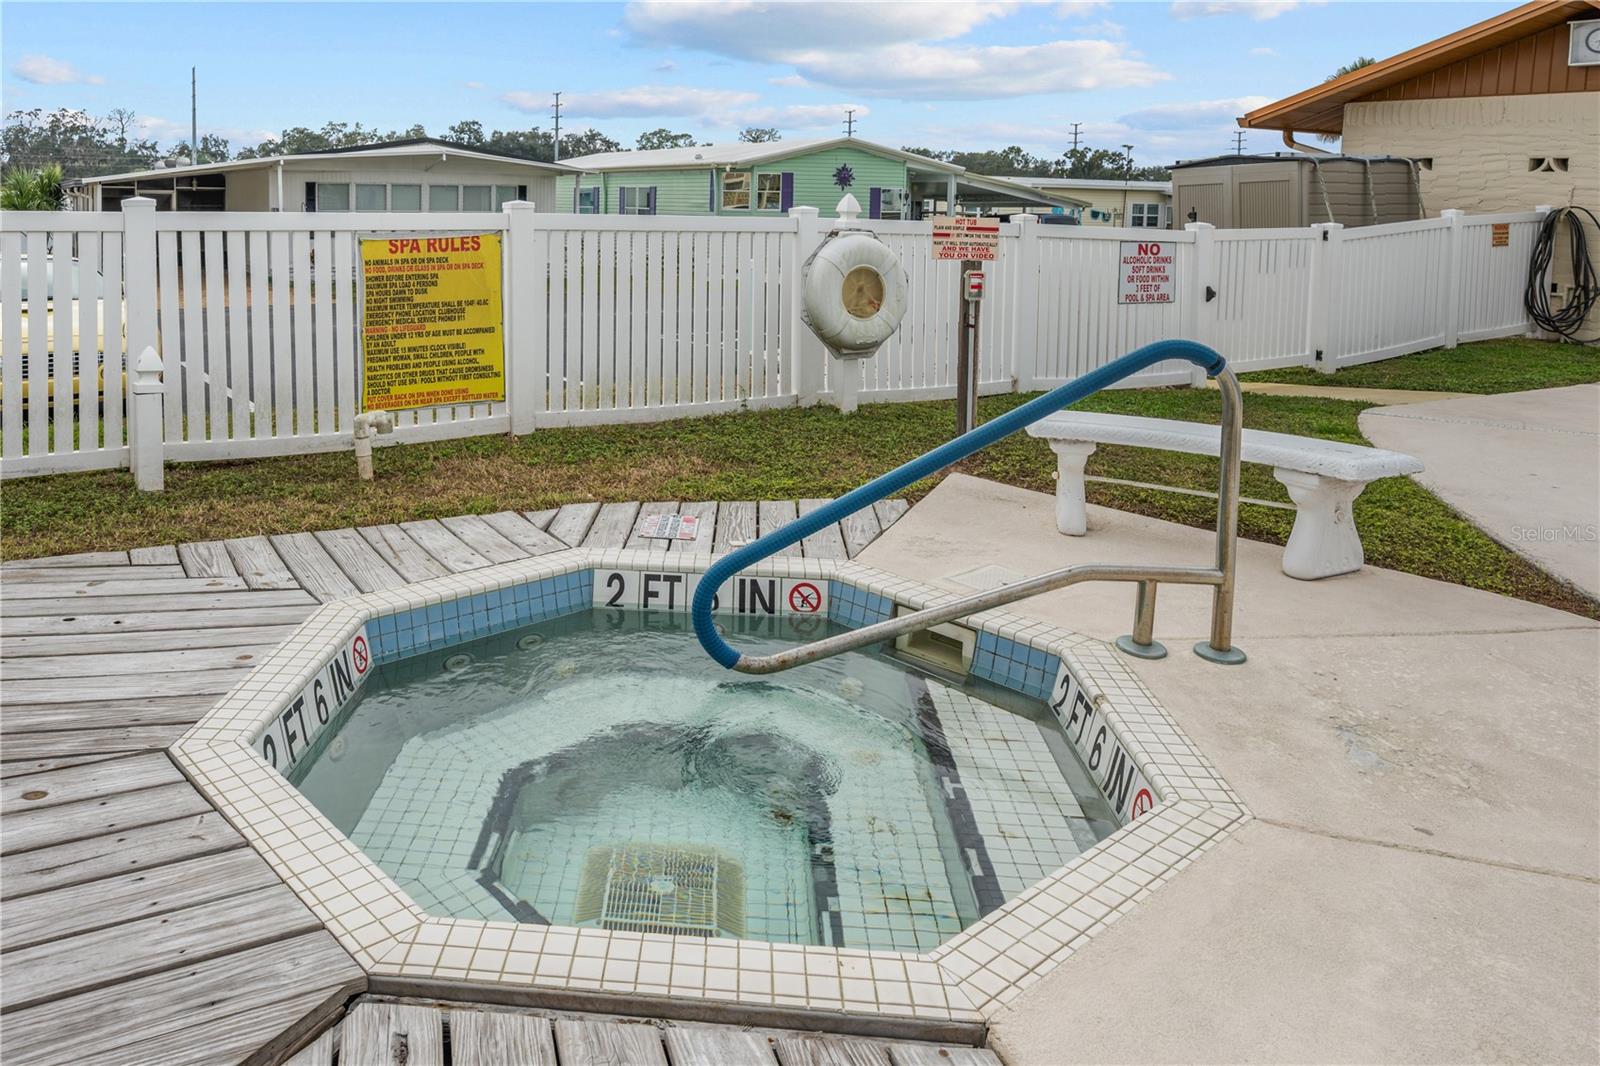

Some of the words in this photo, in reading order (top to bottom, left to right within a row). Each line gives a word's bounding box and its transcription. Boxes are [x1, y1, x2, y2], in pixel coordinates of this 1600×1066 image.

[389, 239, 420, 254] SPA
[427, 236, 481, 253] RULES
[1138, 243, 1160, 256] NO
[1123, 256, 1152, 264] ALCOHOLIC
[1152, 256, 1172, 264] DRINKS
[1132, 265, 1145, 273] SOFT
[1146, 265, 1166, 273] DRINKS
[1127, 275, 1135, 283] OR
[1136, 275, 1150, 283] FOOD
[1136, 284, 1139, 292] 3
[1140, 284, 1152, 292] FEET
[1154, 284, 1160, 292] OF
[1125, 294, 1139, 302] POOL
[1146, 294, 1155, 302] SPA
[407, 302, 440, 310] TEMPERATURE
[464, 327, 495, 335] ACCOMPANIED
[473, 371, 501, 379] CONSULTING
[606, 572, 625, 607] 2
[643, 574, 682, 610] FT
[738, 578, 776, 614] IN
[282, 696, 310, 764] FT
[314, 679, 329, 725] 6
[330, 650, 355, 707] IN
[1052, 674, 1070, 717] 2
[1066, 690, 1094, 745] FT
[1088, 725, 1106, 771] 6
[1102, 746, 1135, 815] IN
